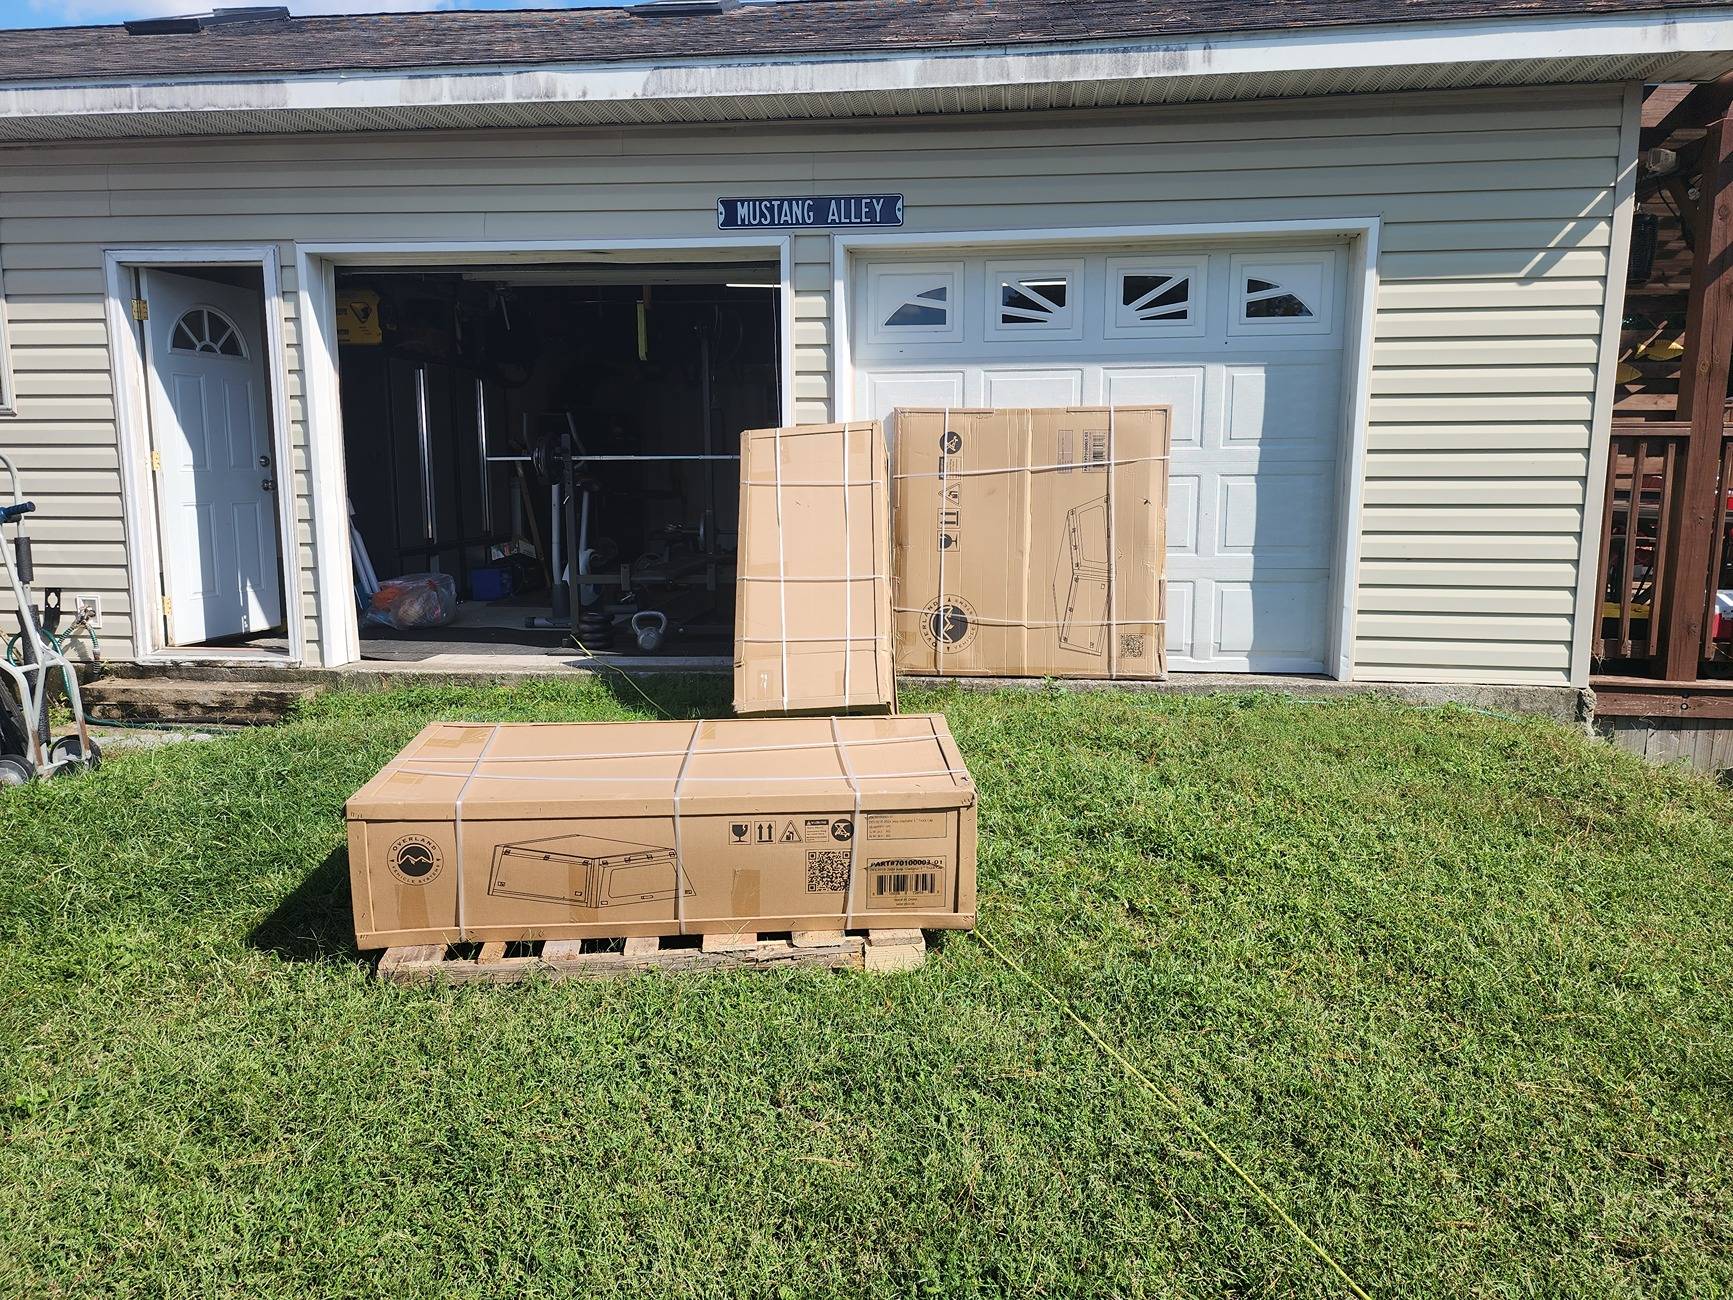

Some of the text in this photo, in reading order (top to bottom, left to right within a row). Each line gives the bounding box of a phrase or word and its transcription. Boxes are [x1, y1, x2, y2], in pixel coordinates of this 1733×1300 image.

[737, 199, 884, 225] MUSTANG ALLEY
[392, 837, 437, 851] OVERLAND
